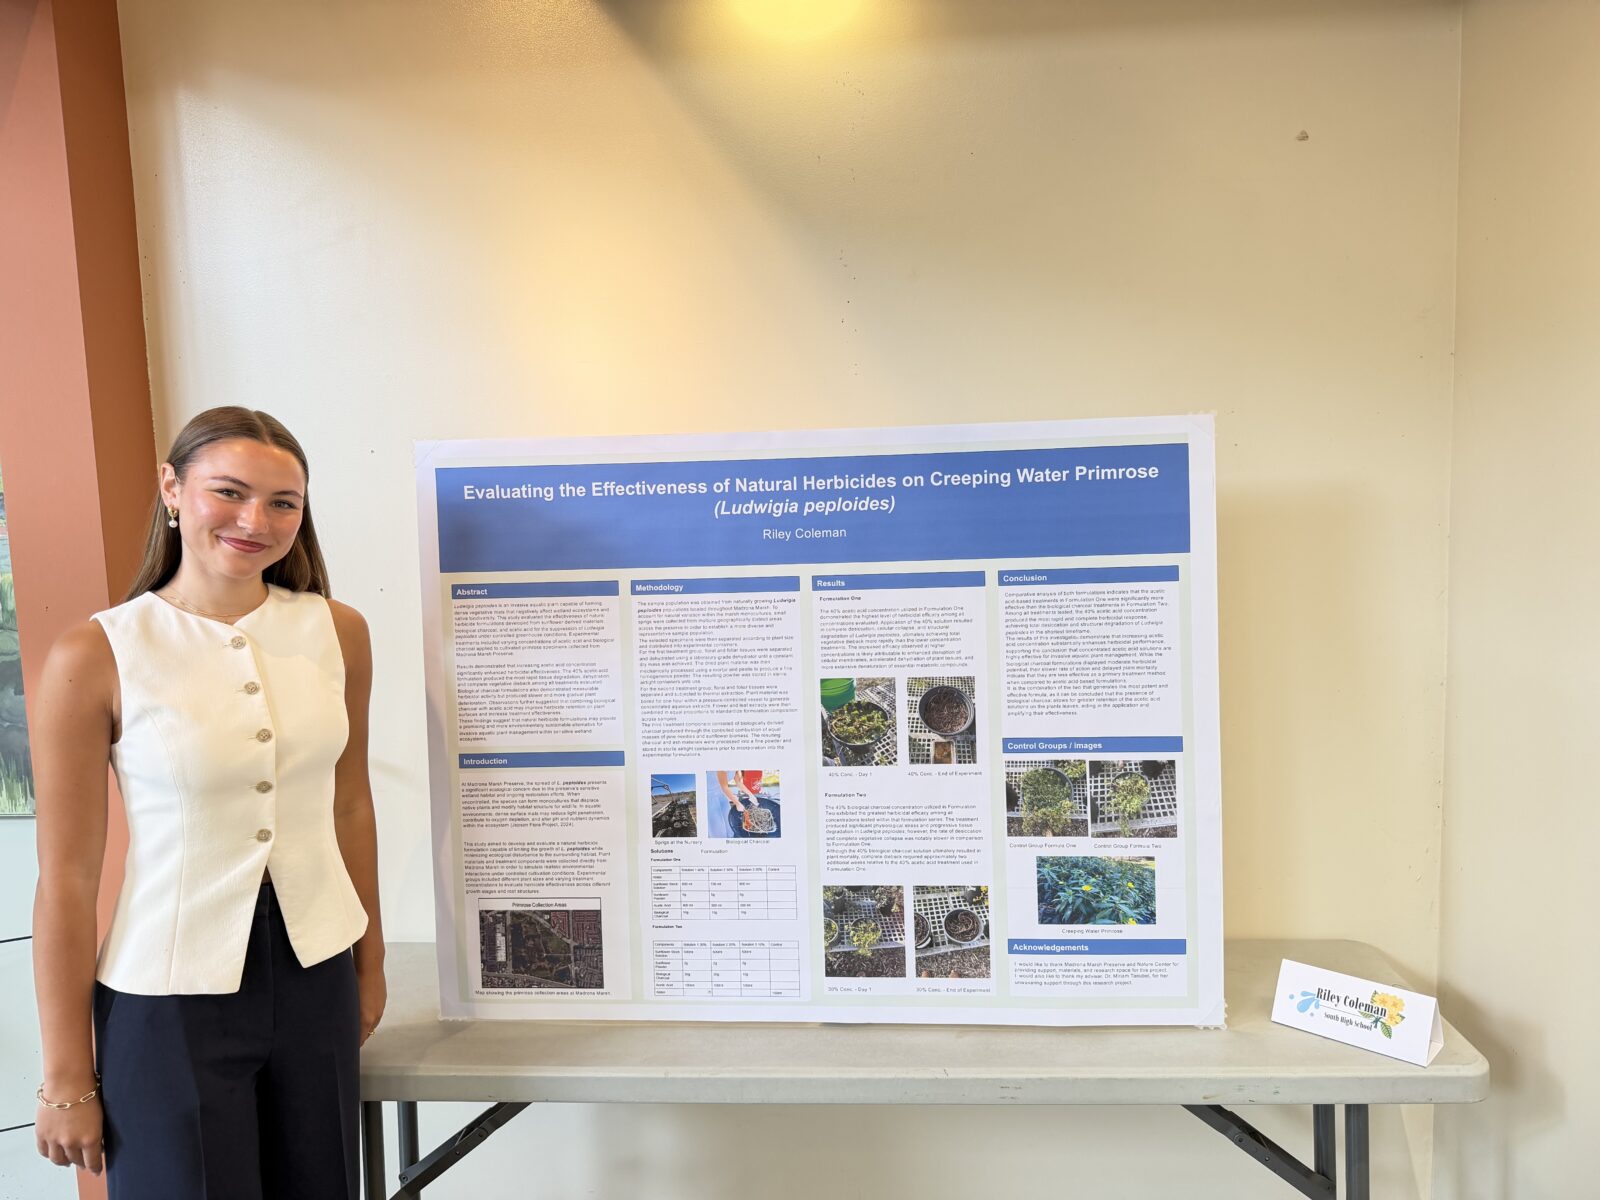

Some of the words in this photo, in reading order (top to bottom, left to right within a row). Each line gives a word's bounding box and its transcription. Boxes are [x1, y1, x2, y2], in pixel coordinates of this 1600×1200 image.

[463, 483, 554, 502] Evaluating
[558, 482, 587, 498] the
[591, 480, 708, 497] Effectiveness
[712, 478, 731, 493] of
[735, 476, 797, 493] Natural
[803, 473, 897, 490] Herbicides
[902, 475, 924, 487] on
[930, 469, 1011, 488] Creeping
[1016, 467, 1070, 483] Water
[1075, 465, 1159, 481] Primrose
[714, 498, 799, 519] (Ludwigia
[803, 495, 896, 516] peploides)
[762, 528, 792, 542] Riley
[795, 527, 847, 540] Coleman
[1003, 574, 1047, 582] Conclusion
[456, 588, 488, 596] Abstract
[635, 584, 684, 592] Methodology
[1007, 742, 1037, 750] Control
[1038, 742, 1068, 751] Groups
[1074, 742, 1103, 751] Images
[1012, 943, 1089, 952] Acknowledgements
[1316, 987, 1343, 1007] Riley
[1344, 995, 1387, 1018] Coleman
[1324, 1012, 1340, 1022] South
[1340, 1016, 1354, 1027] High
[1354, 1020, 1372, 1032] School
